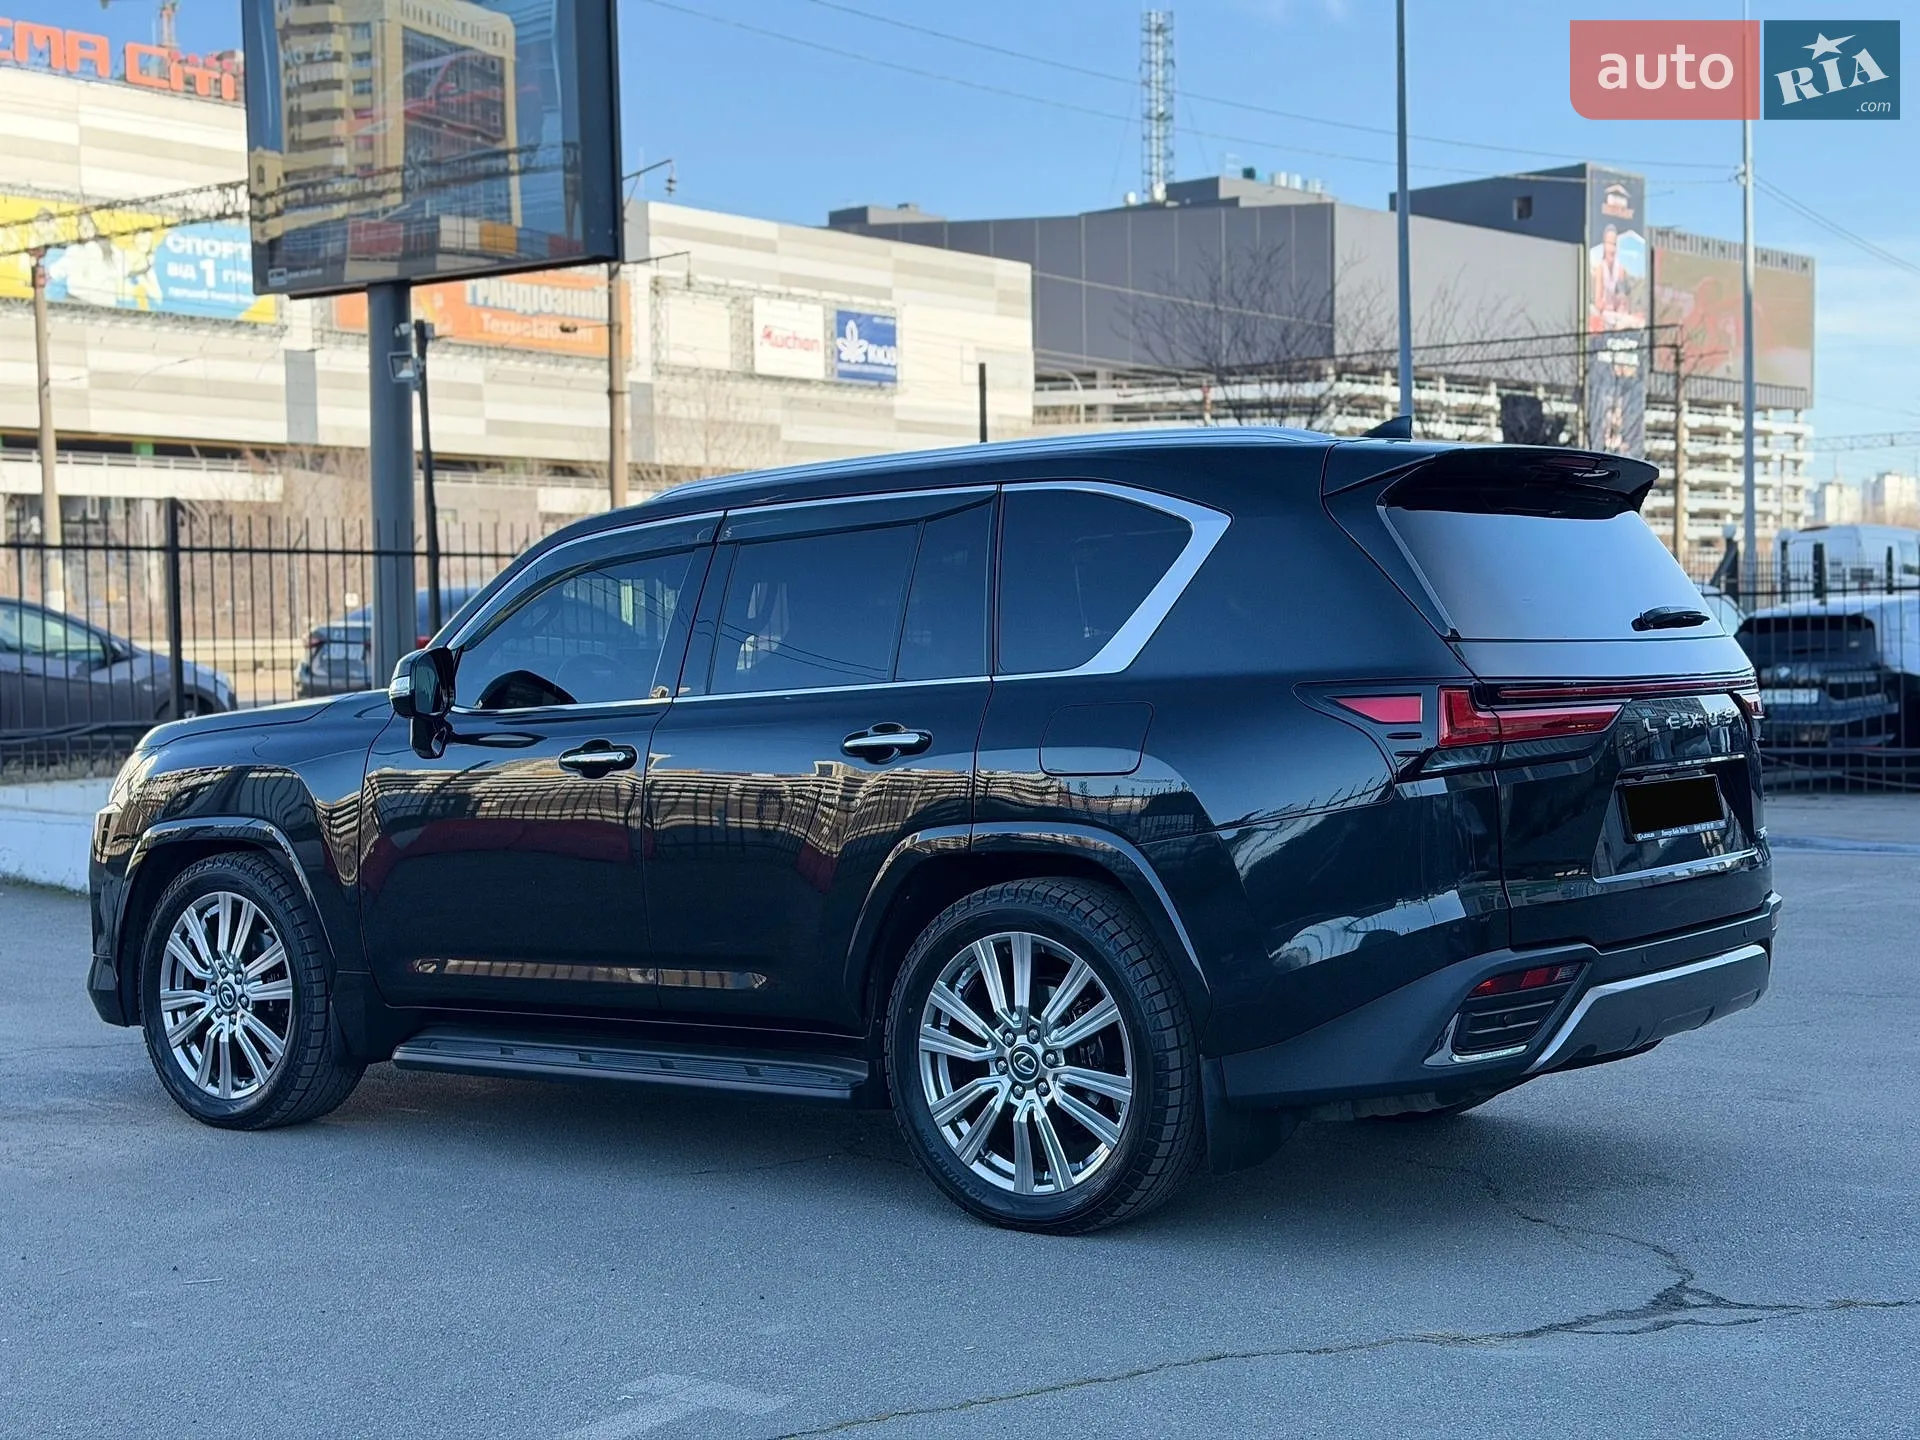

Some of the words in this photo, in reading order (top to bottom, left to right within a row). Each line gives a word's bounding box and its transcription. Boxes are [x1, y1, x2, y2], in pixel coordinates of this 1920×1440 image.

[199, 258, 216, 289] 1
[761, 325, 820, 354] Auchan
[1643, 708, 1733, 733] LEXUS
